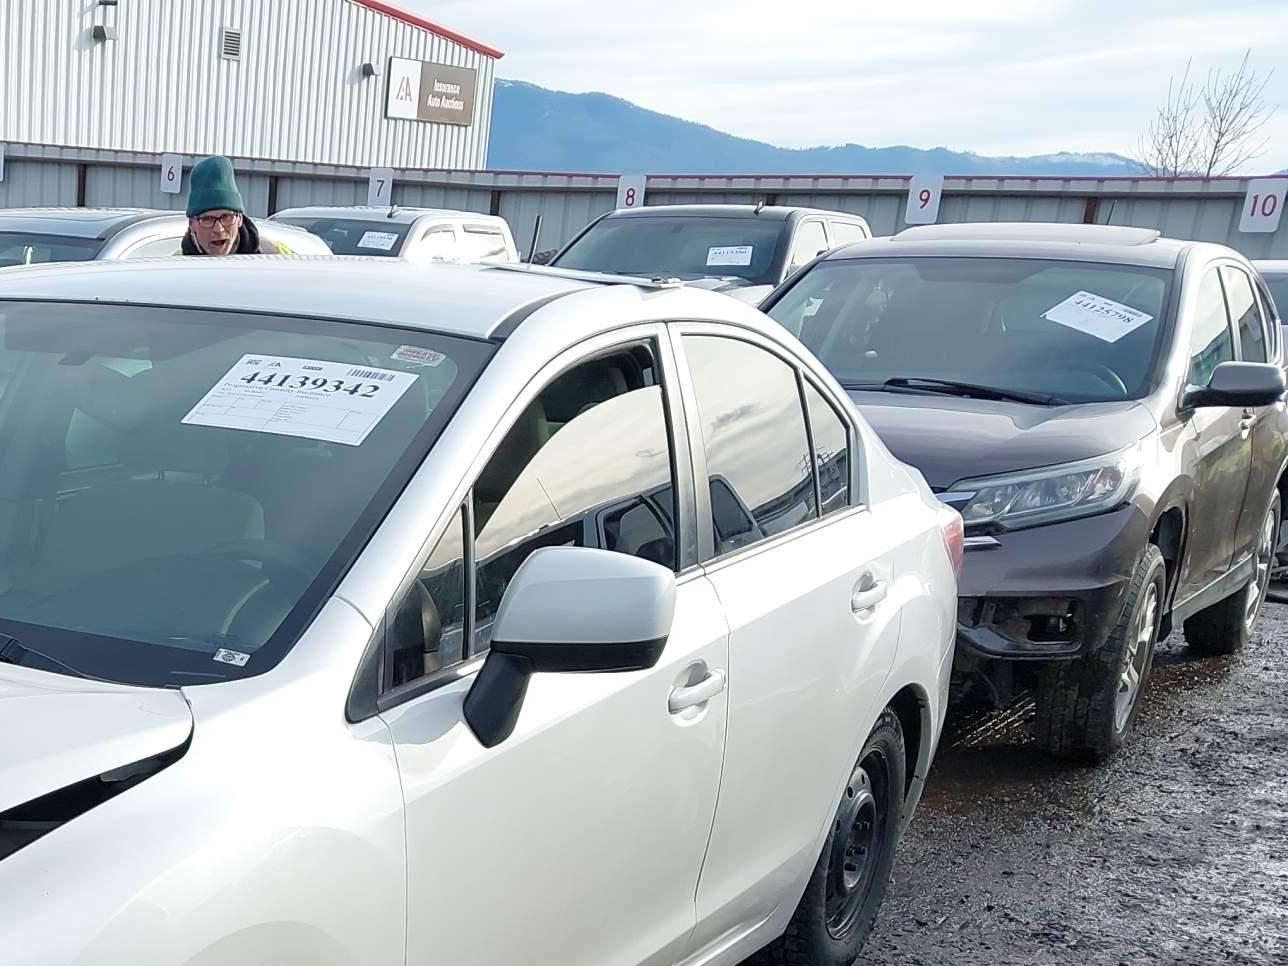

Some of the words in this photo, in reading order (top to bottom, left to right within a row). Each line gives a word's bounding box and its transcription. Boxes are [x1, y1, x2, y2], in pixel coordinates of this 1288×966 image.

[434, 79, 461, 95] Insurance
[427, 94, 441, 107] Auto
[440, 95, 464, 110] Auctions
[167, 166, 175, 181] 6
[376, 180, 385, 198] 7
[625, 188, 636, 207] 8
[919, 189, 931, 209] 9
[1249, 194, 1278, 217] 10
[1074, 299, 1134, 324] 44125798
[241, 370, 381, 399] 44139342
